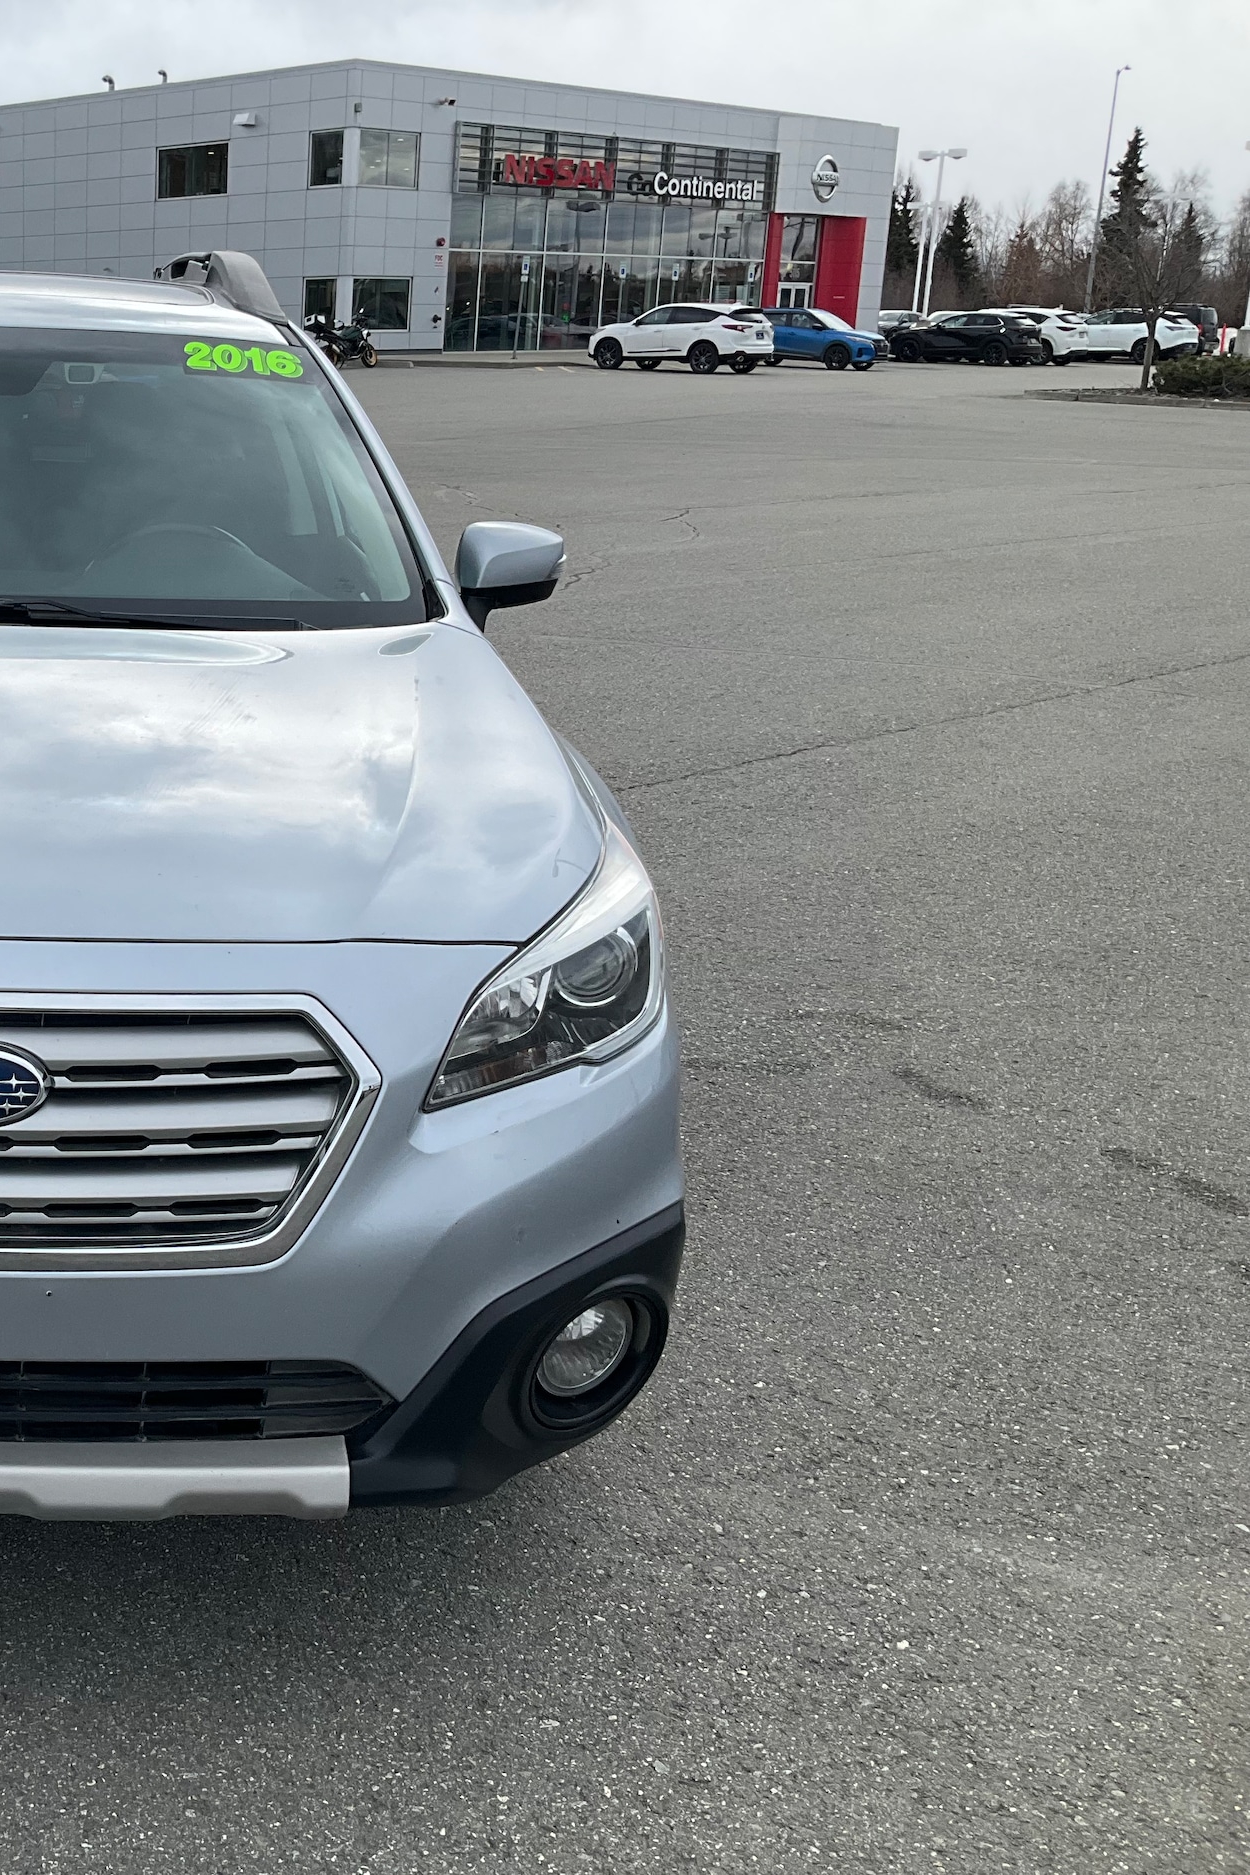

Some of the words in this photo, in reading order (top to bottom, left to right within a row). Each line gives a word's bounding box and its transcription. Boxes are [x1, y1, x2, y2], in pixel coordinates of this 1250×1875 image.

[505, 154, 615, 191] NISSAN
[653, 171, 758, 201] Continental
[183, 341, 304, 378] 2016
